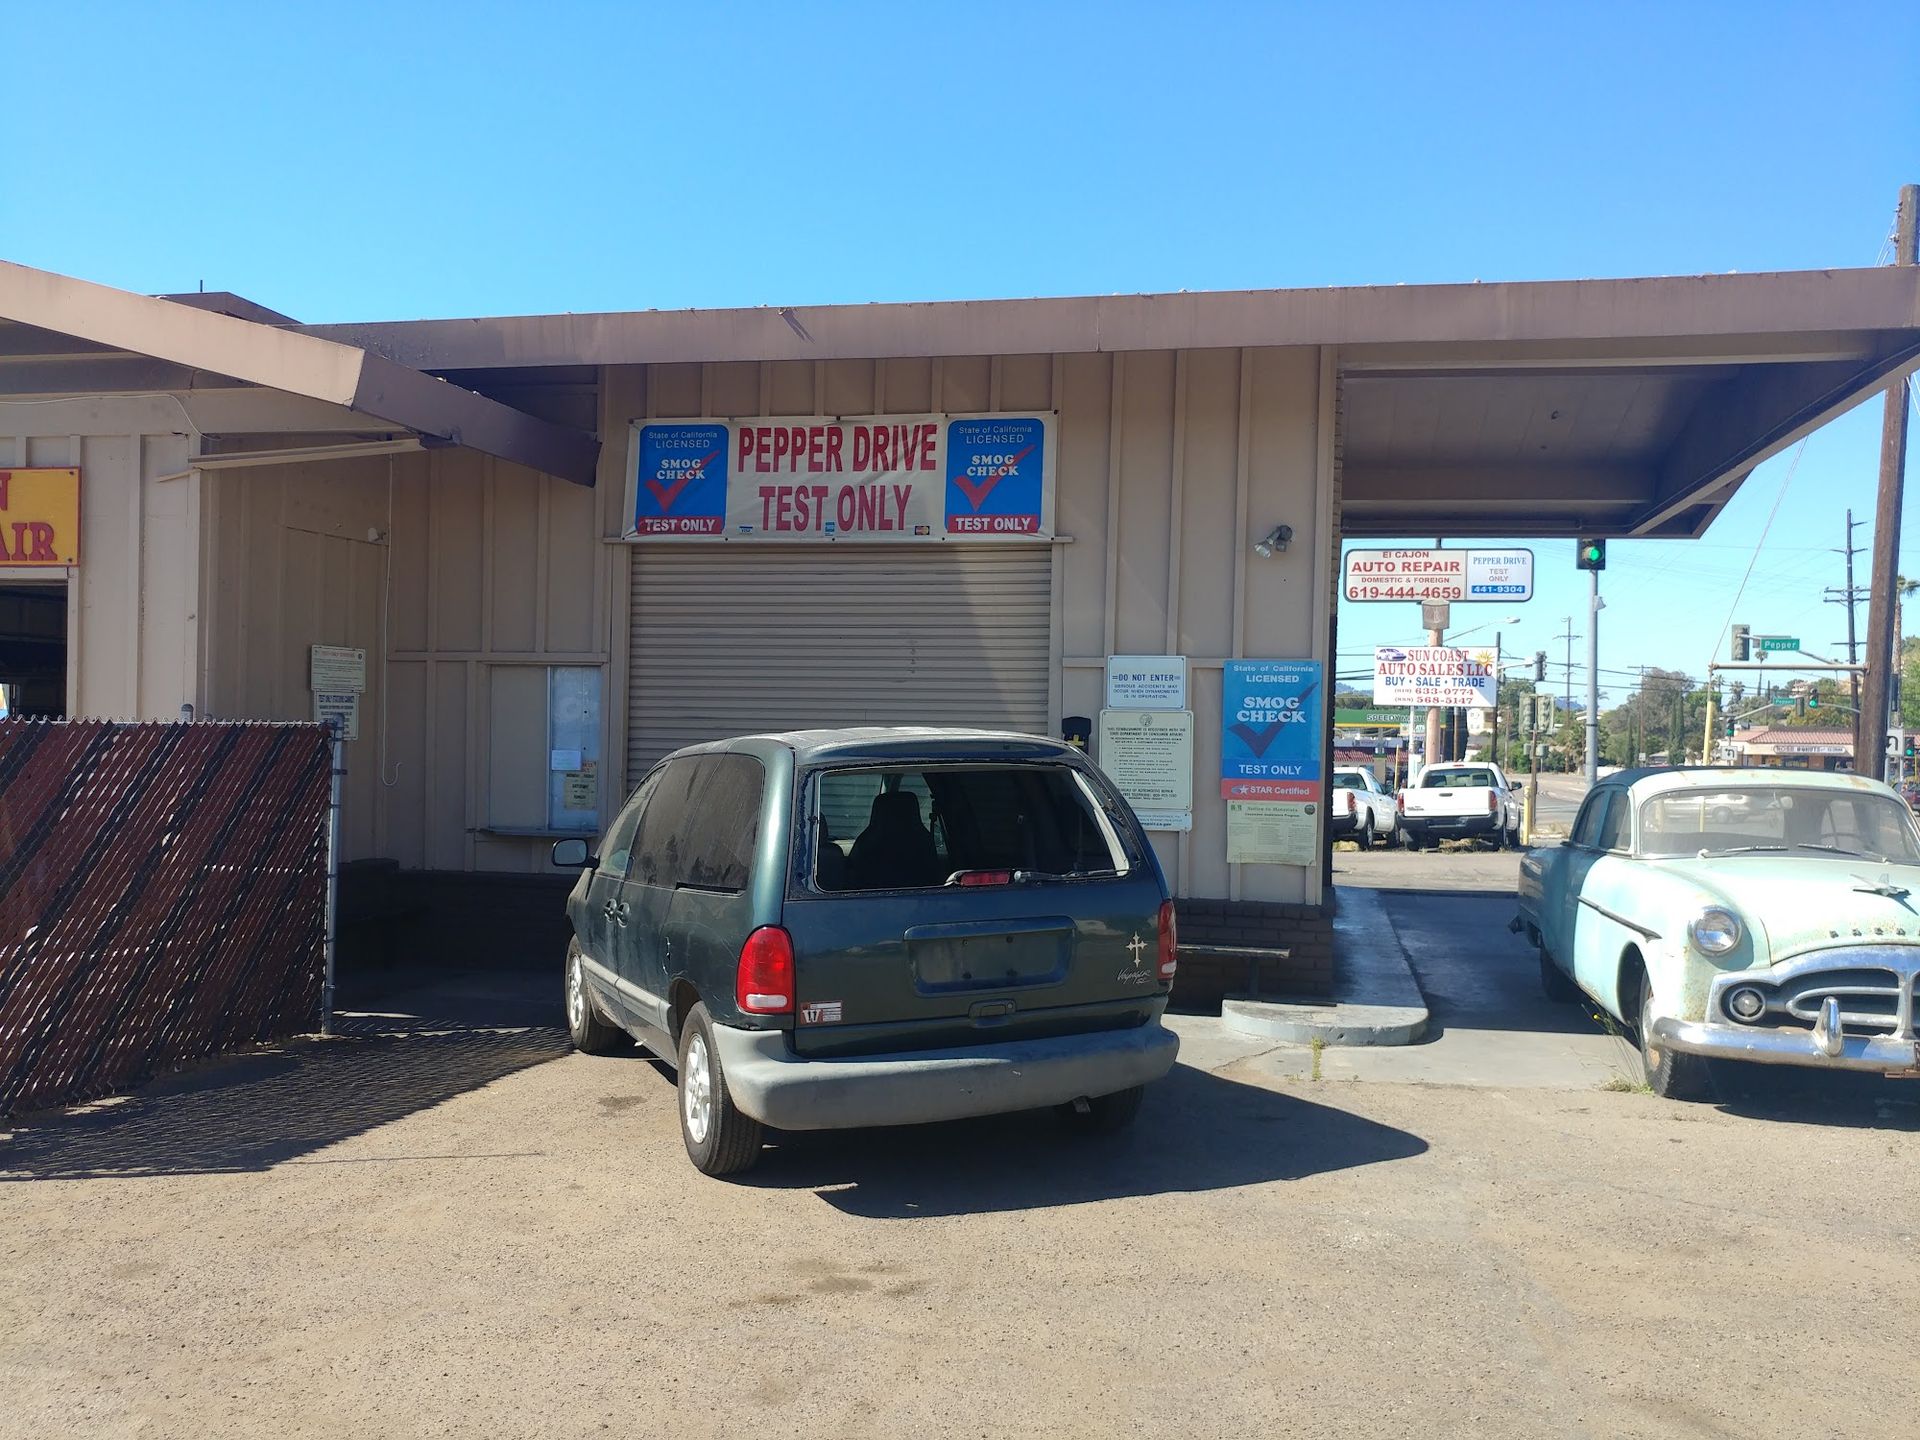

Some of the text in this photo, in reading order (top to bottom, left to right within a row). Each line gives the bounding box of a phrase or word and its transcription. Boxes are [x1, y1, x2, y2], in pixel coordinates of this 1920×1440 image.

[959, 426, 980, 434] State
[992, 425, 1033, 434] California
[648, 431, 718, 439] State of California
[966, 434, 1024, 444] LICENSED
[656, 440, 710, 449] LICENSED
[738, 424, 938, 473] PEPPER DRIVE
[661, 459, 702, 469] SMOG
[971, 454, 1015, 465] SMOG
[656, 470, 706, 480] CHECK
[966, 466, 1019, 476] CHECK
[758, 484, 913, 532] TEST ONLY
[645, 519, 716, 532] TEST ONLY
[956, 517, 1031, 531] TEST ONLY
[1473, 556, 1527, 565] PEPPER DRIVE
[1352, 561, 1461, 573] AUTO REPAIR
[1350, 586, 1461, 599] 619-444-4659
[1764, 640, 1797, 650] Pepper
[1407, 649, 1470, 662] SUN COAST
[1378, 662, 1493, 677] AUTO SALES LLC
[1118, 673, 1174, 682] DO NOT ENTER
[1246, 675, 1300, 683] LICENSED
[1385, 676, 1485, 688] BUY SALE TRADE
[1415, 687, 1474, 695] 633-0774
[1243, 696, 1300, 709] SMOG
[1416, 696, 1474, 705] 568-5147
[1236, 710, 1306, 723] CHECK
[1239, 764, 1302, 775] TEST ONLY
[1250, 786, 1310, 795] STAR Certified
